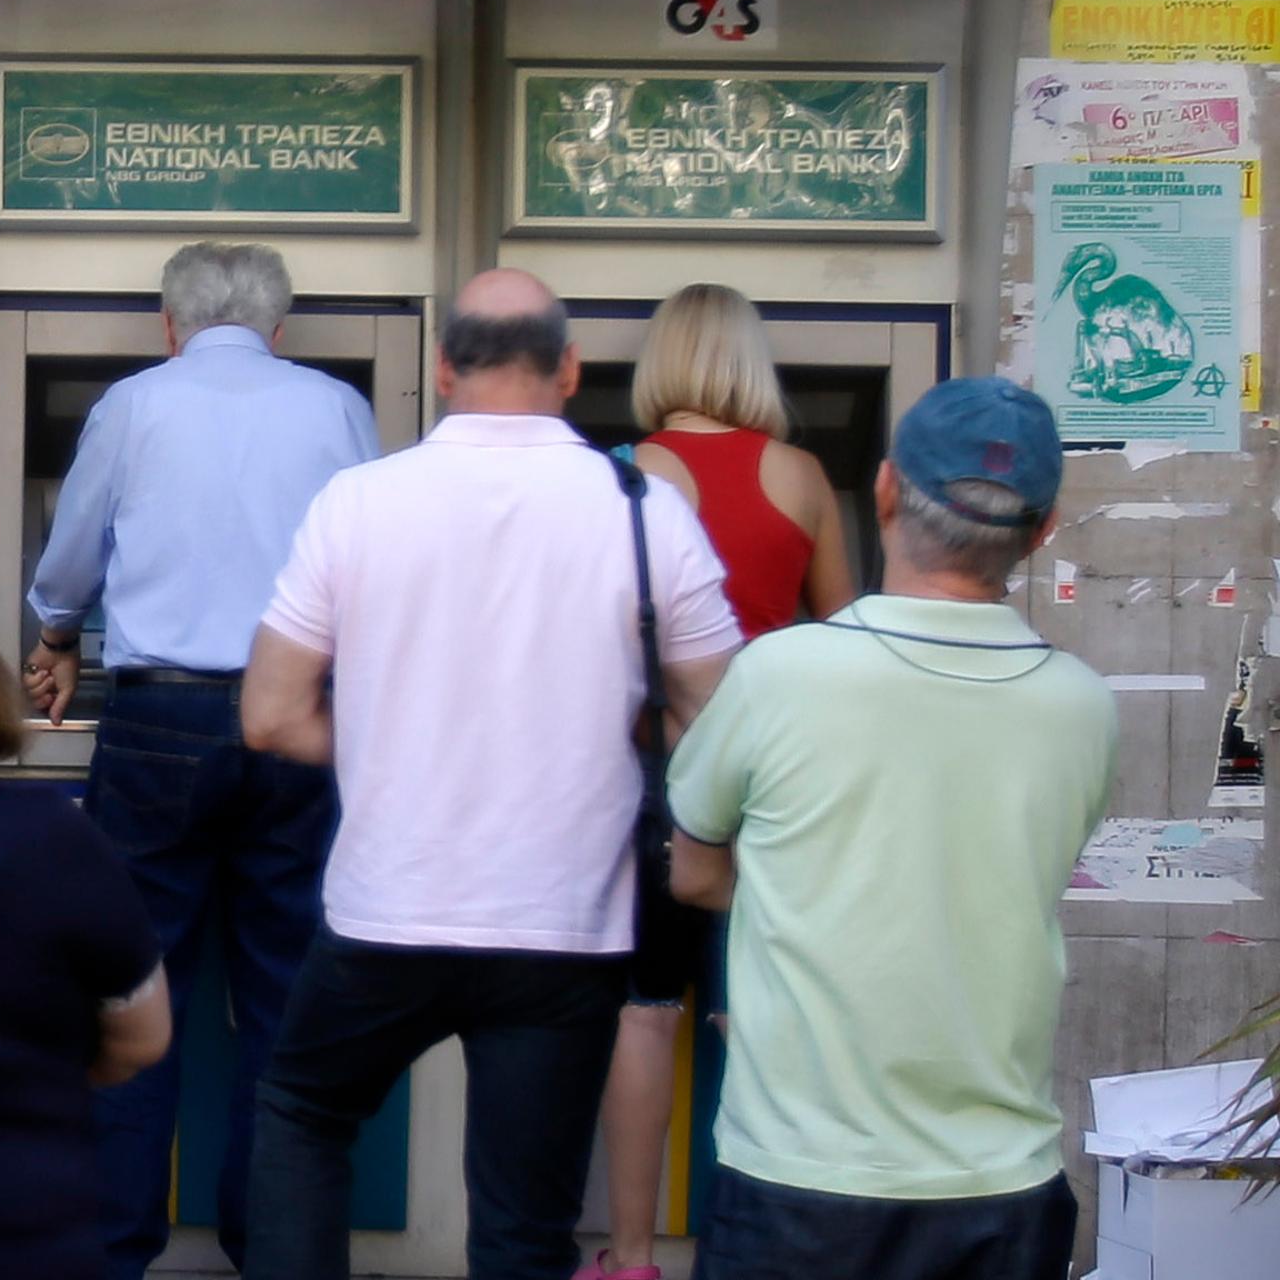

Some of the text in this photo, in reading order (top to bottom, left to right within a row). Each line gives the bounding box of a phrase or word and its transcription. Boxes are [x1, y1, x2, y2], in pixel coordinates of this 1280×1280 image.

[106, 122, 386, 147] ΕΘΝΙΚΗ ΤΡΑΠΕΖΑ
[626, 128, 909, 150] ΕΘΝΙΚΗ ΤΡΑΠΕΖΑ
[105, 147, 360, 170] NATIONAL BANK
[792, 153, 881, 174] BANK
[144, 170, 206, 183] GROUP
